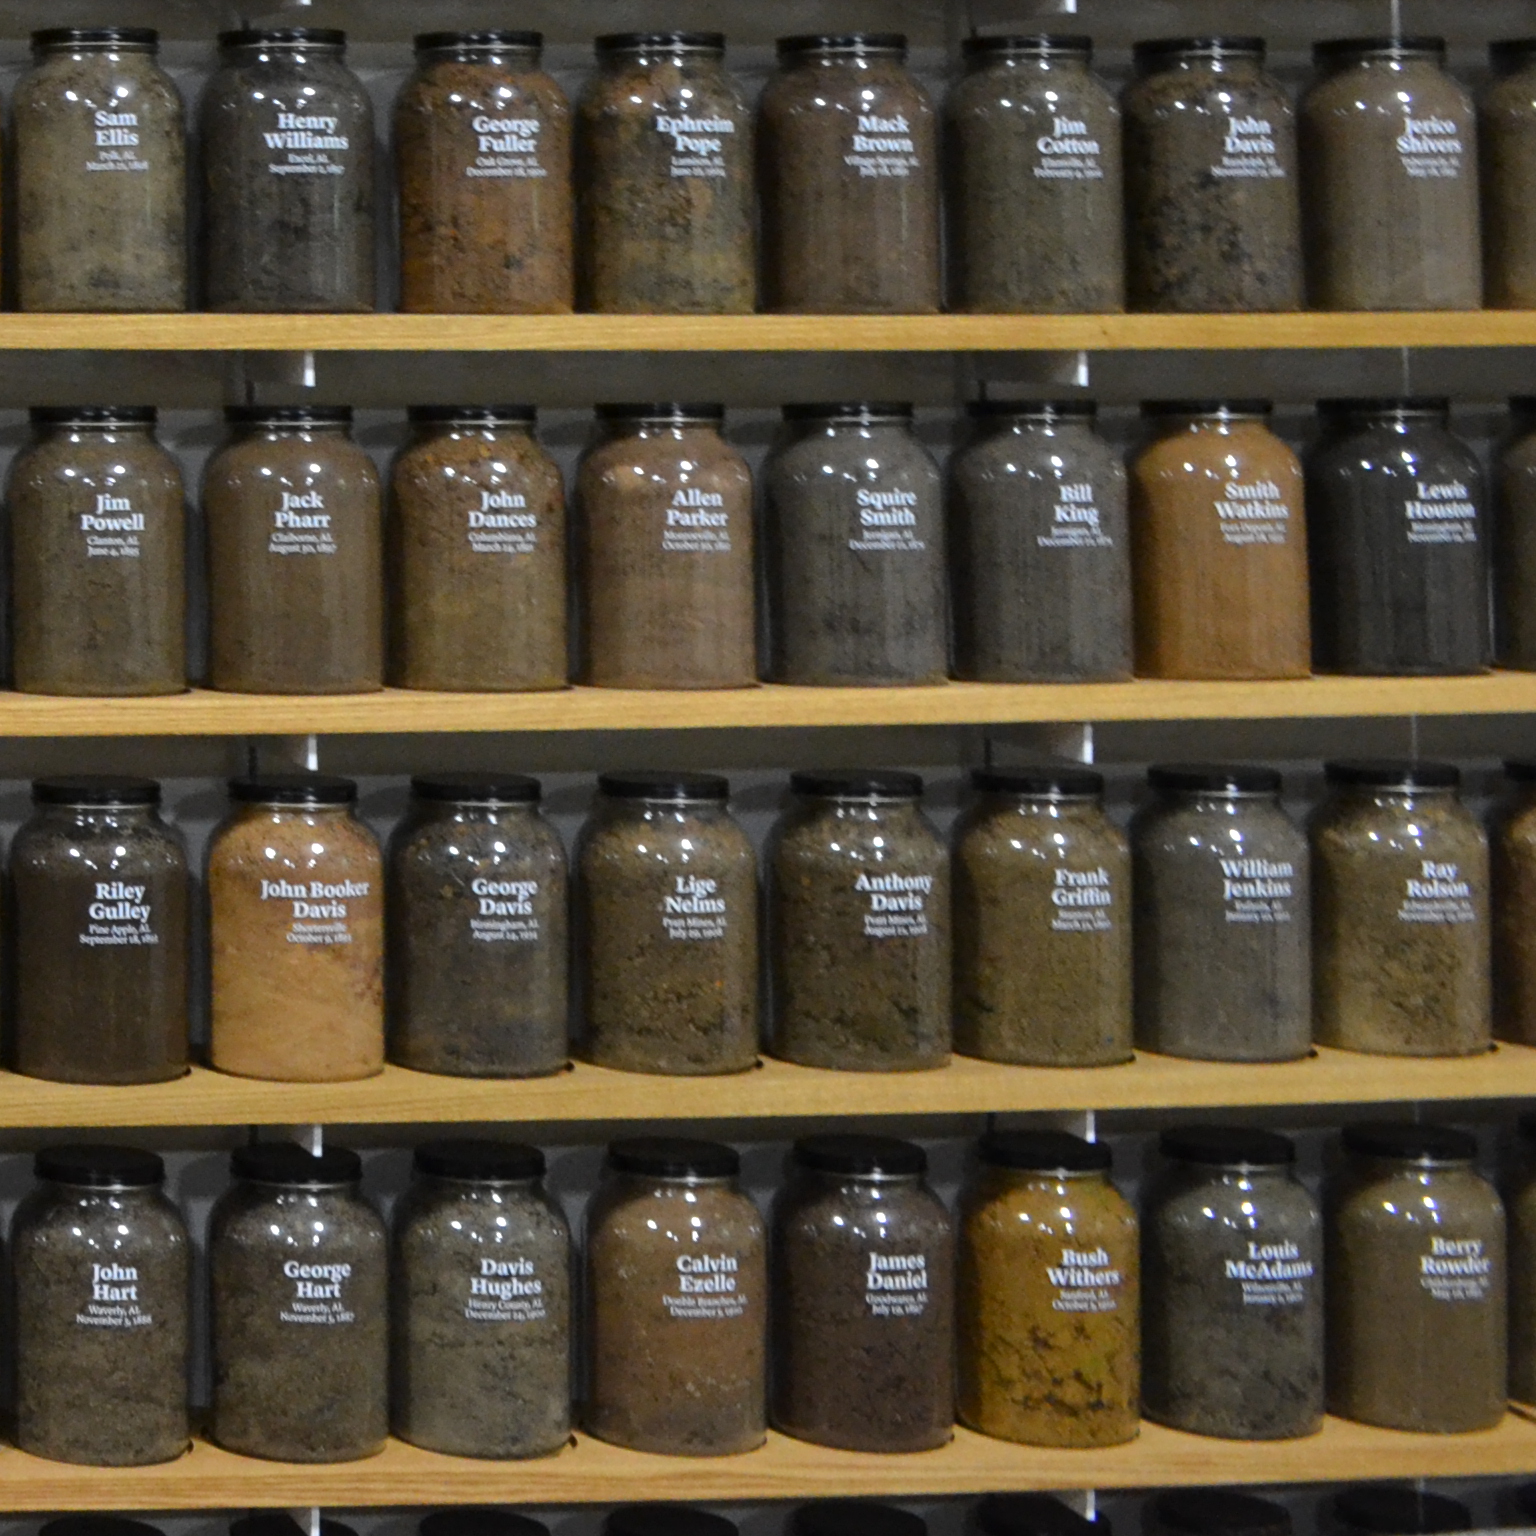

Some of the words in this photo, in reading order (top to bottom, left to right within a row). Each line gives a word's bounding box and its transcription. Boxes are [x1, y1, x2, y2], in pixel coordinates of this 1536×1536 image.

[472, 116, 541, 137] George
[1052, 117, 1088, 137] Jim
[478, 134, 538, 152] Fuller
[1036, 137, 1100, 155] Cotton
[671, 489, 724, 508] Allen
[1059, 484, 1094, 503] Bill
[96, 495, 131, 514] Jim
[81, 514, 145, 531] Powell
[666, 508, 729, 527] Parker
[1053, 504, 1100, 526] King
[94, 883, 146, 904] Riley
[260, 880, 308, 900] John
[309, 880, 370, 899] Booker
[88, 901, 151, 923] Gulley
[293, 900, 347, 918] Davis
[676, 1255, 738, 1274] Calvin
[869, 1252, 926, 1271] James
[1061, 1248, 1109, 1266] Bush
[480, 1258, 534, 1276] Davis
[1045, 1266, 1120, 1286] Withers
[470, 1276, 542, 1297] Hughes
[679, 1274, 736, 1293] Ezelle
[866, 1271, 928, 1291] Daniel
